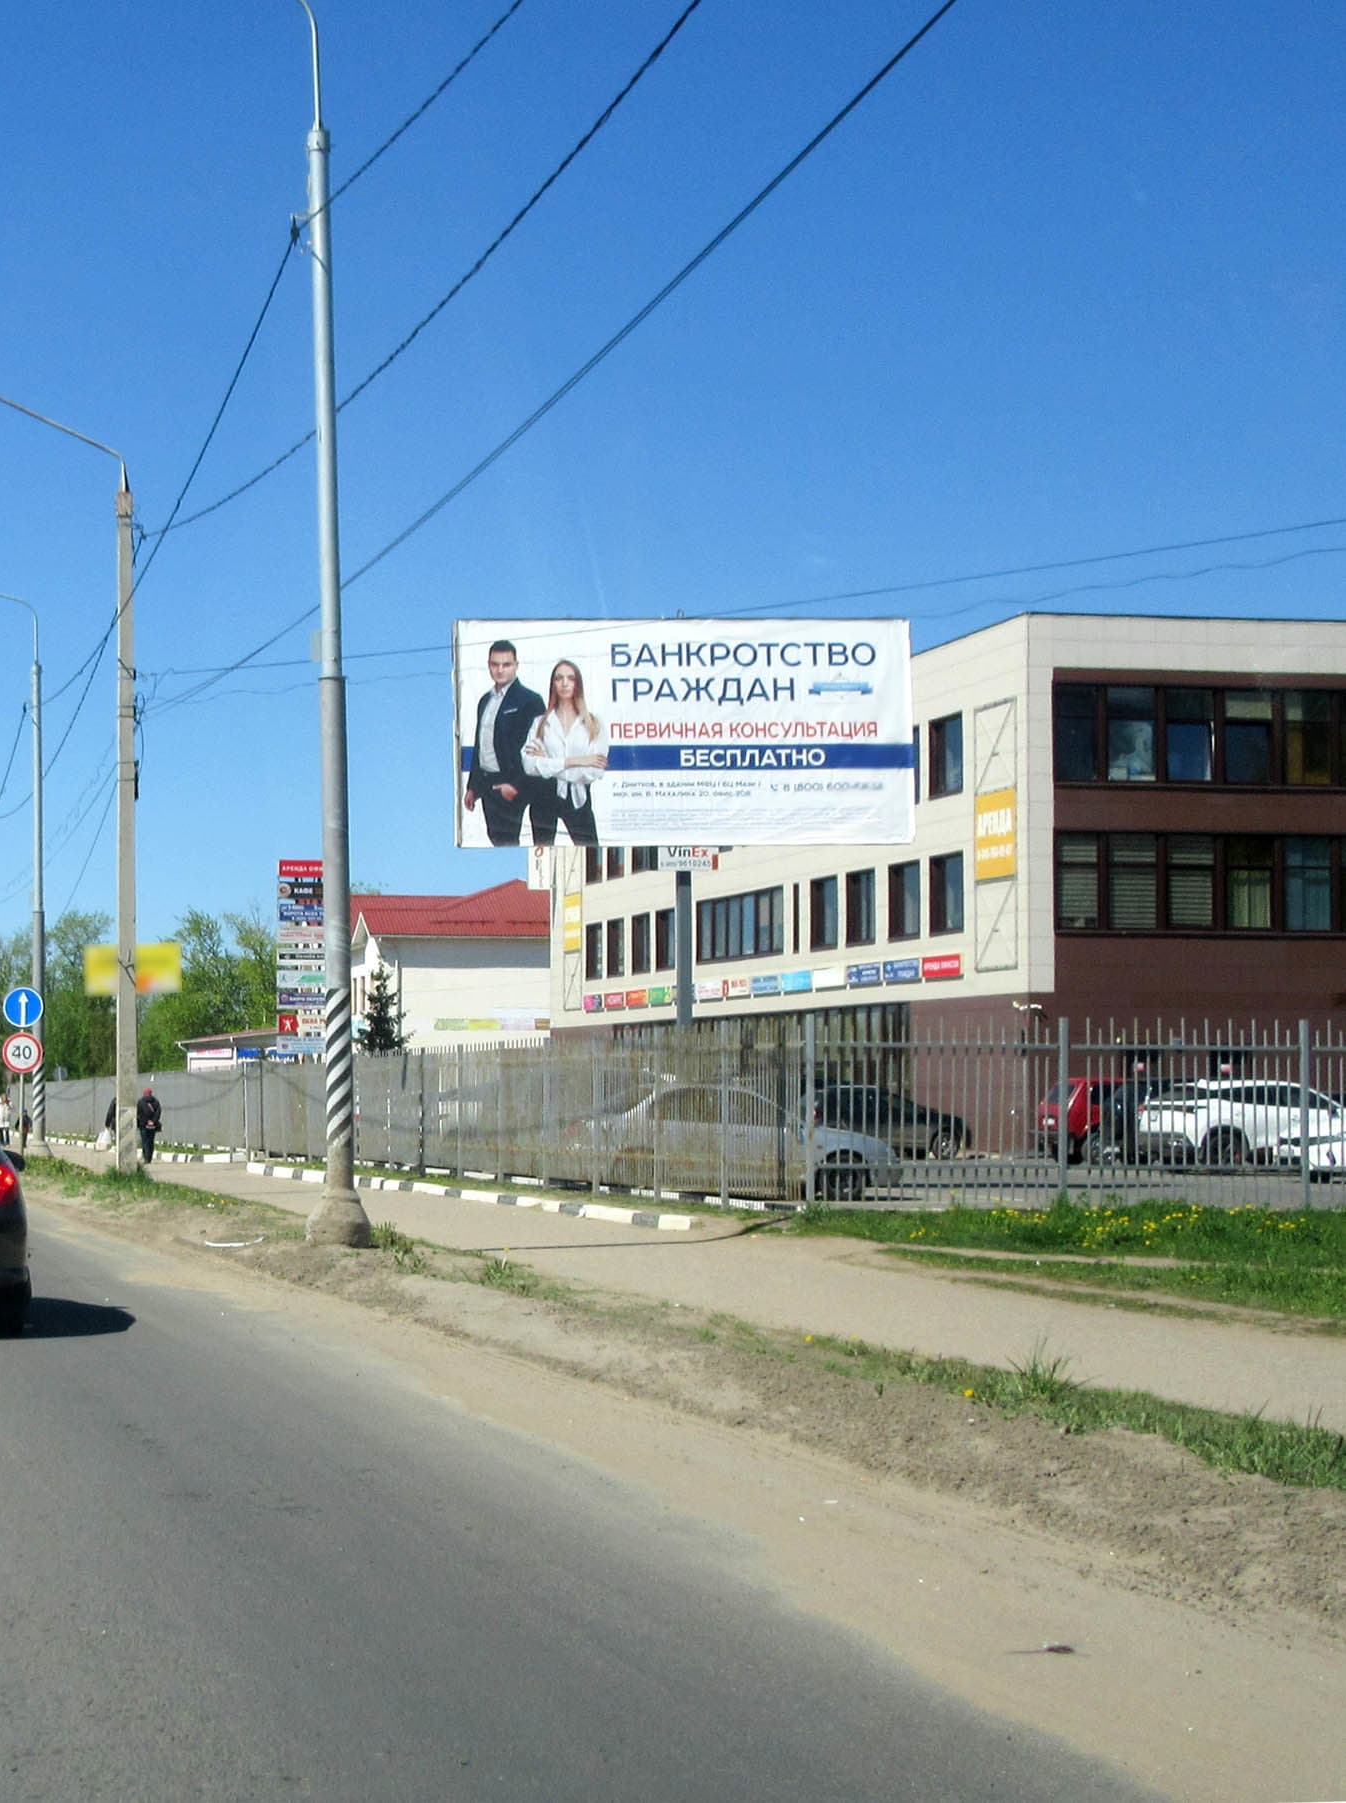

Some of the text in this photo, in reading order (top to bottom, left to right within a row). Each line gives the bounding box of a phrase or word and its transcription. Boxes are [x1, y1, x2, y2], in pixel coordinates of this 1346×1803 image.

[610, 642, 876, 668] БАНКРОТСТВО
[611, 677, 795, 706] ГРАЖДАН
[610, 720, 878, 740] ПЕРВИЧНАЯ КОНСУЛЬТАЦИЯ
[679, 748, 826, 767] БЕСПЛАТНО
[976, 807, 1013, 838] АРЕНДА
[281, 864, 308, 872] АРЕНДА
[12, 1045, 32, 1060] 40
